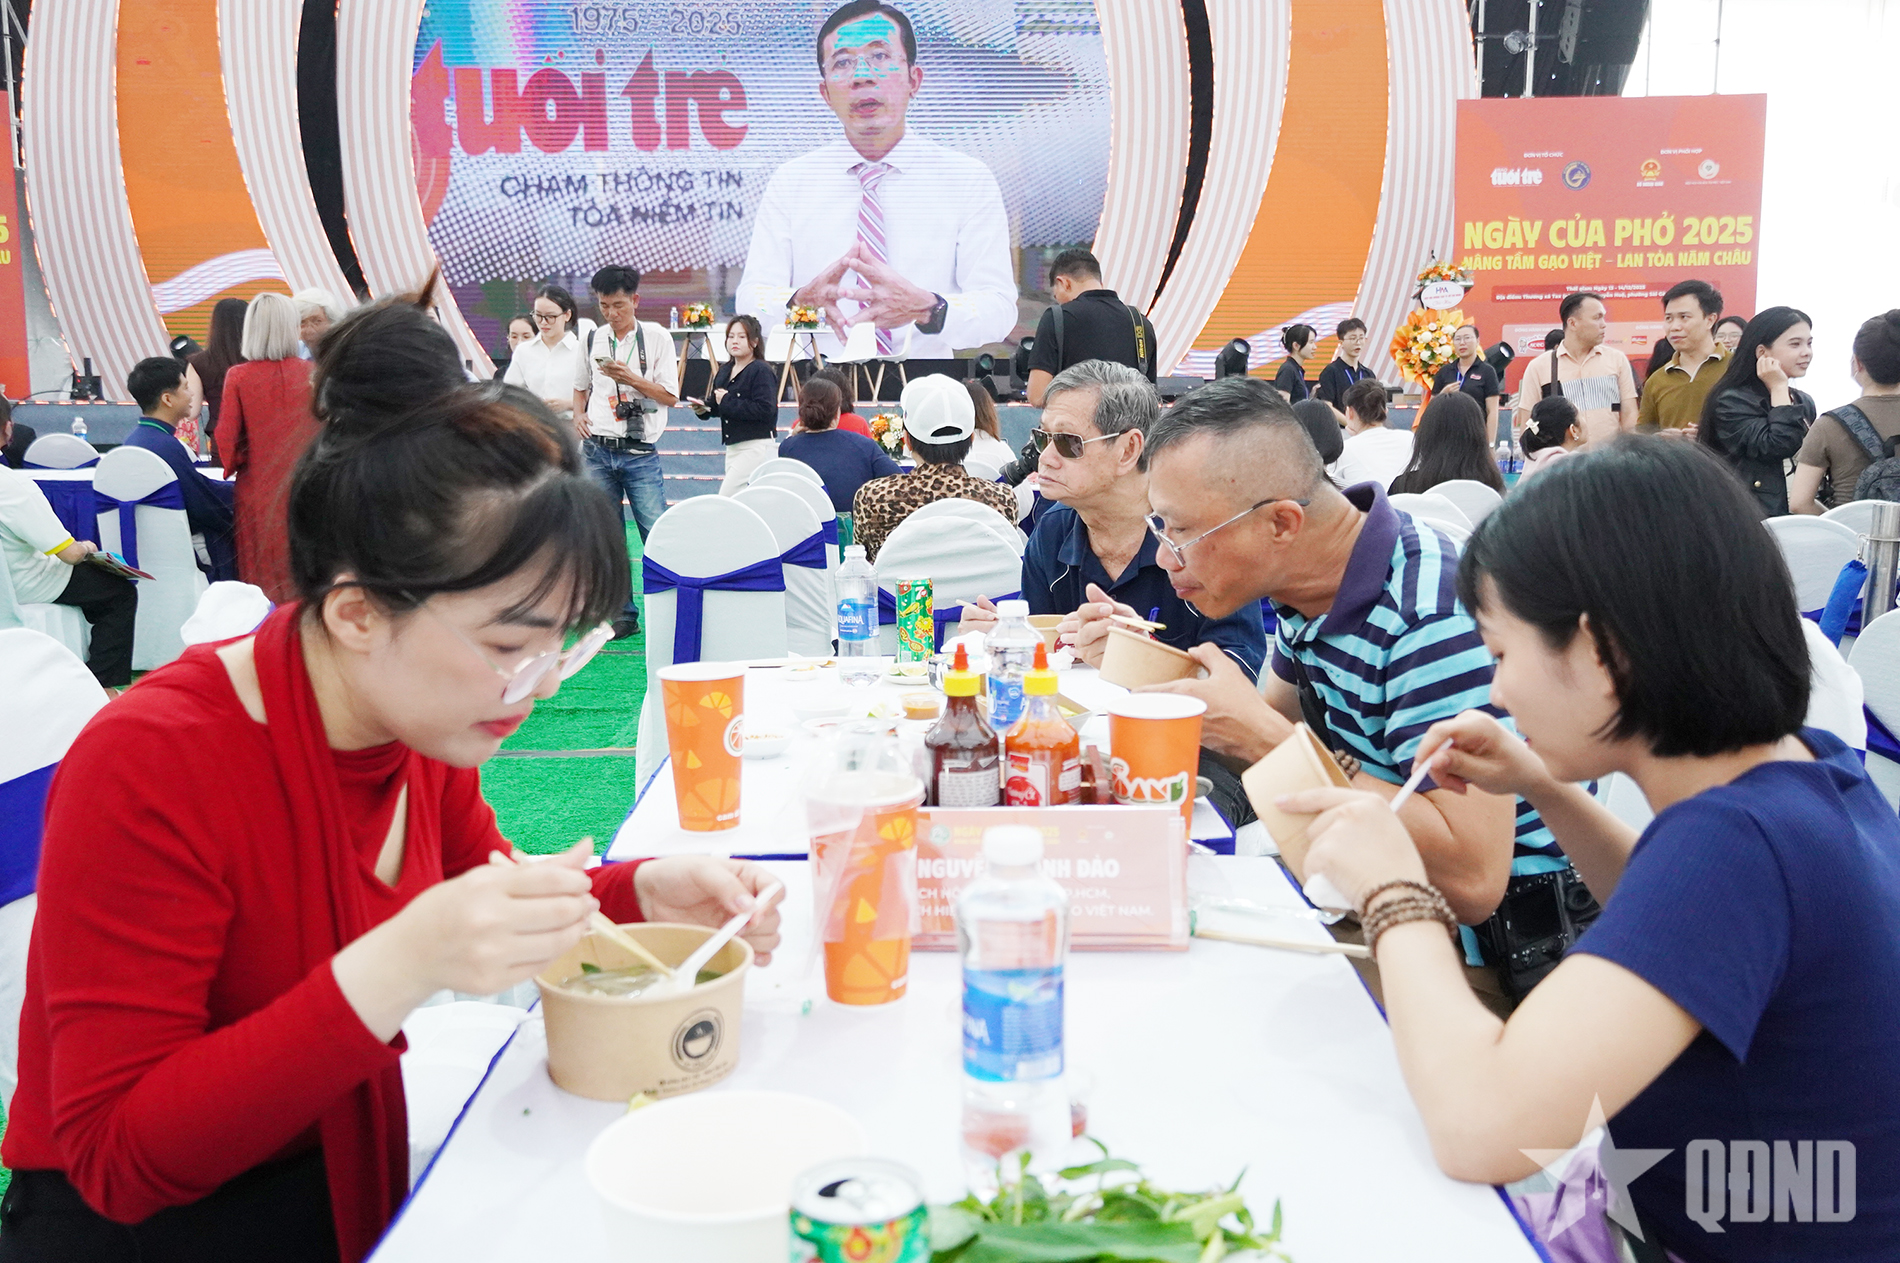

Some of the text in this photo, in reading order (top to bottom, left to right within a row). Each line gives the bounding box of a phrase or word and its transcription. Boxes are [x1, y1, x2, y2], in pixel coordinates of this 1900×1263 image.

[569, 6, 640, 36] 1975
[669, 8, 743, 36] 2025
[701, 170, 743, 190] TIN
[702, 201, 743, 221] TIN
[1464, 210, 1754, 250] NGÀY CỦA PHỞ 2025
[1463, 254, 1502, 271] NÂNG
[1506, 251, 1535, 270] TẦM
[1538, 254, 1569, 271] GẠO
[1572, 251, 1602, 271] VIỆT
[1617, 253, 1645, 268] LAN
[1713, 248, 1752, 266] CHÂU
